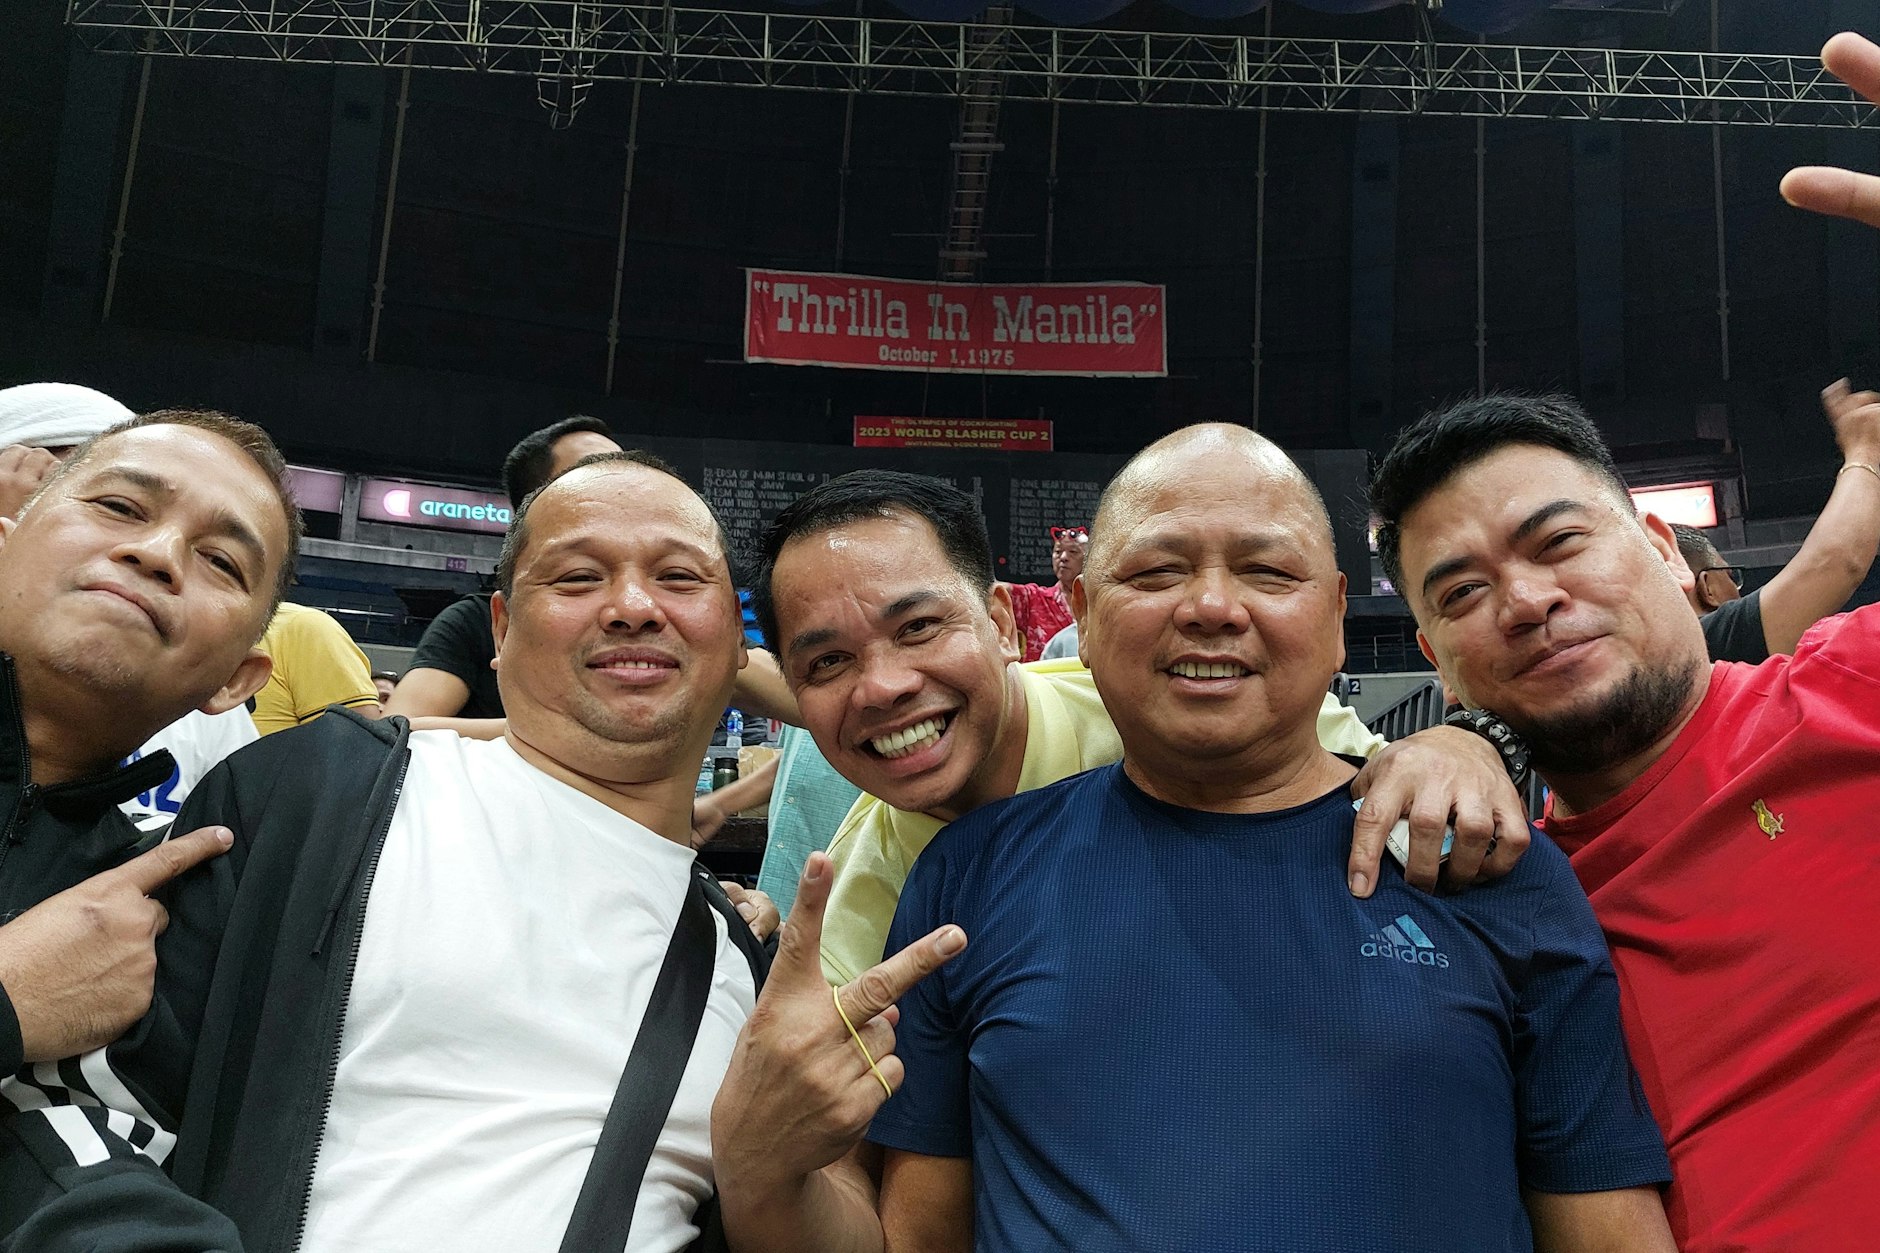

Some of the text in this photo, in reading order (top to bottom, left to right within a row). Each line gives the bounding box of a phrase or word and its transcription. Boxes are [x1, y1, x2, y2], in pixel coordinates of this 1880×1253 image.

[928, 293, 970, 341] In
[879, 344, 938, 364] October
[960, 420, 1018, 428] COCKFIGHTING
[858, 427, 1049, 442] 2023 WORLD SLASHER CUP 2
[420, 501, 511, 524] araneta
[448, 560, 465, 570] 412
[1361, 942, 1450, 968] adidas
